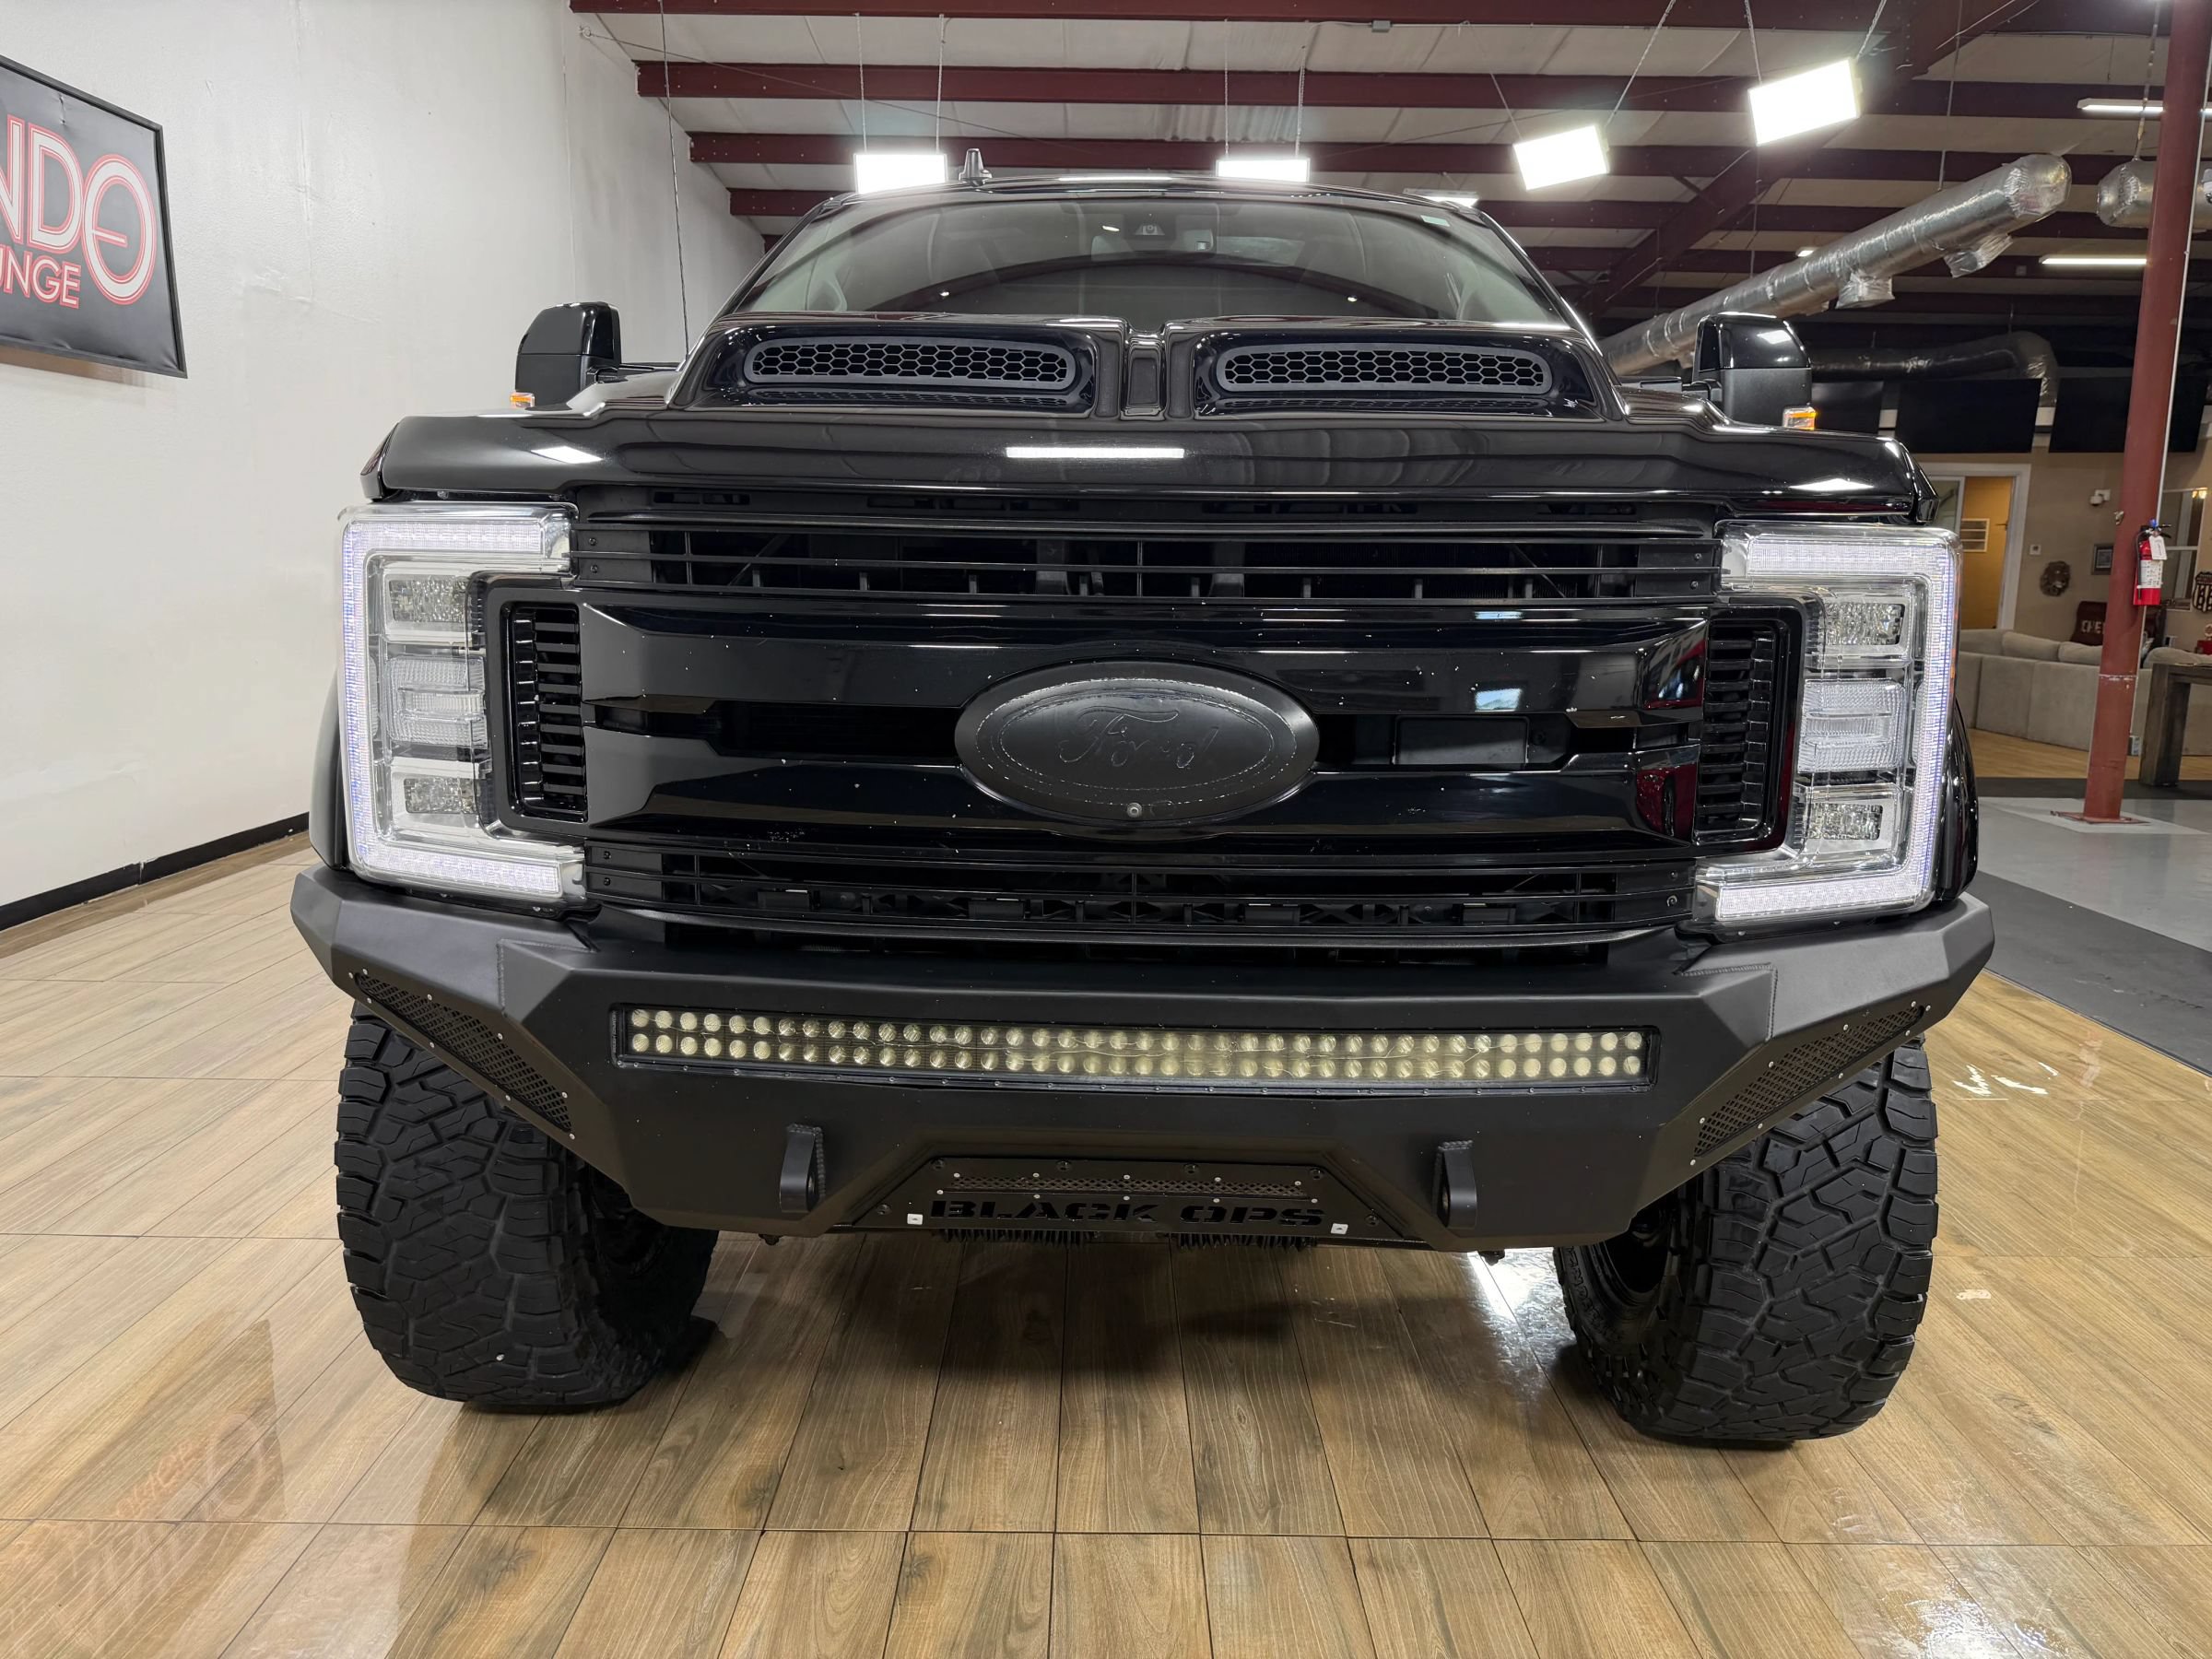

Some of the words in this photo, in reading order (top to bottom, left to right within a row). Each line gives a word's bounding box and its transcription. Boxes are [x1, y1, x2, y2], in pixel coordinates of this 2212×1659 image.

[0, 245, 81, 309] NGE
[1057, 704, 1218, 769] Ford
[930, 1200, 1159, 1222] BLACK
[1181, 1205, 1325, 1226] OPS
